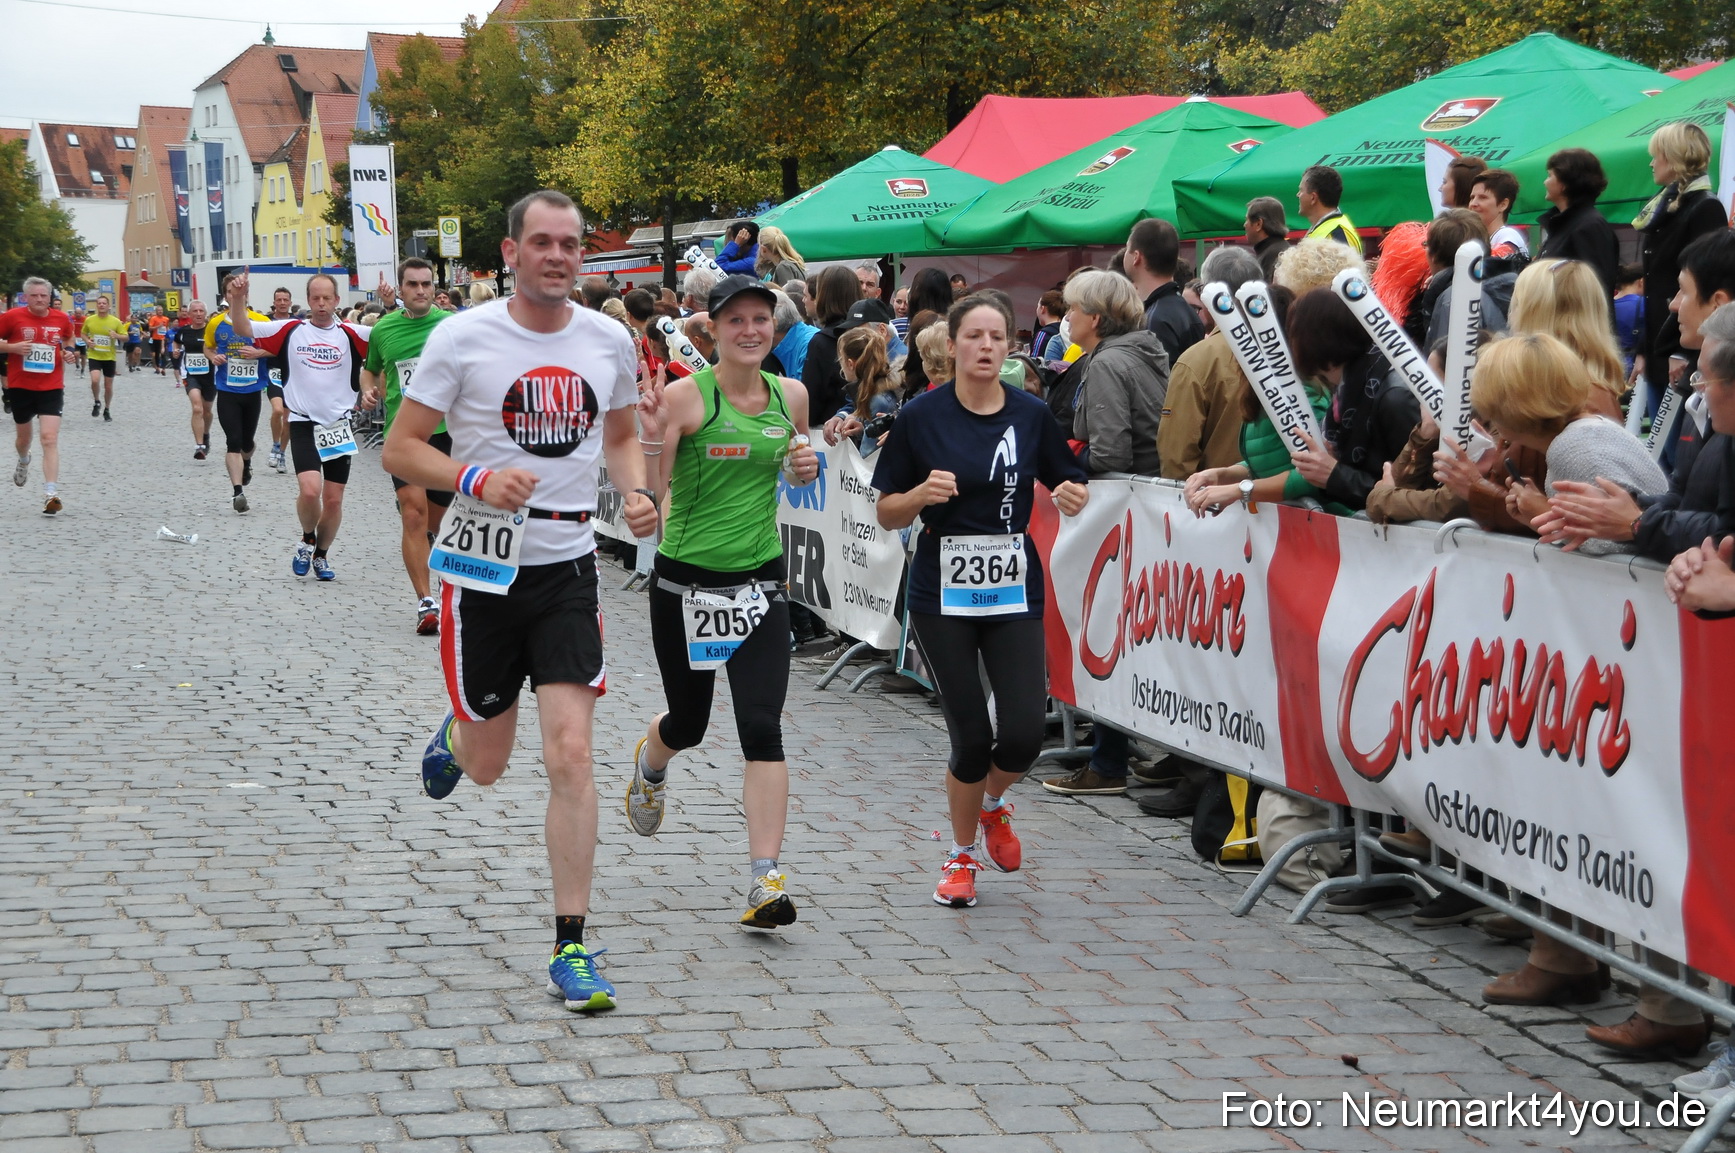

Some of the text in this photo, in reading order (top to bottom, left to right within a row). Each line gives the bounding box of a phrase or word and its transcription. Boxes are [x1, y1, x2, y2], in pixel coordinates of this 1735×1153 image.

[170, 297, 177, 307] D
[1230, 322, 1269, 374] BMW
[1363, 306, 1412, 360] BMW
[26, 350, 53, 362] 2043
[187, 358, 207, 367] 2458
[1257, 327, 1293, 379] BMW
[230, 365, 255, 376] 2916
[519, 375, 584, 413] TOKYO
[318, 428, 351, 447] 3354
[515, 411, 589, 446] RUNNER
[709, 447, 748, 457] OBI
[468, 506, 510, 522] Neumarkt
[441, 515, 514, 560] 2610
[942, 542, 1011, 552] PARTL Neumarkt
[441, 556, 501, 582] Alexander
[950, 554, 1019, 585] 2364
[971, 592, 999, 605] Stine
[1079, 507, 1253, 682] Charivari
[693, 606, 765, 638] 2056
[1337, 566, 1637, 783] Charivari
[1132, 673, 1265, 751] Ostbayerns Radio
[1424, 781, 1654, 908] Ostbayerns Radio
